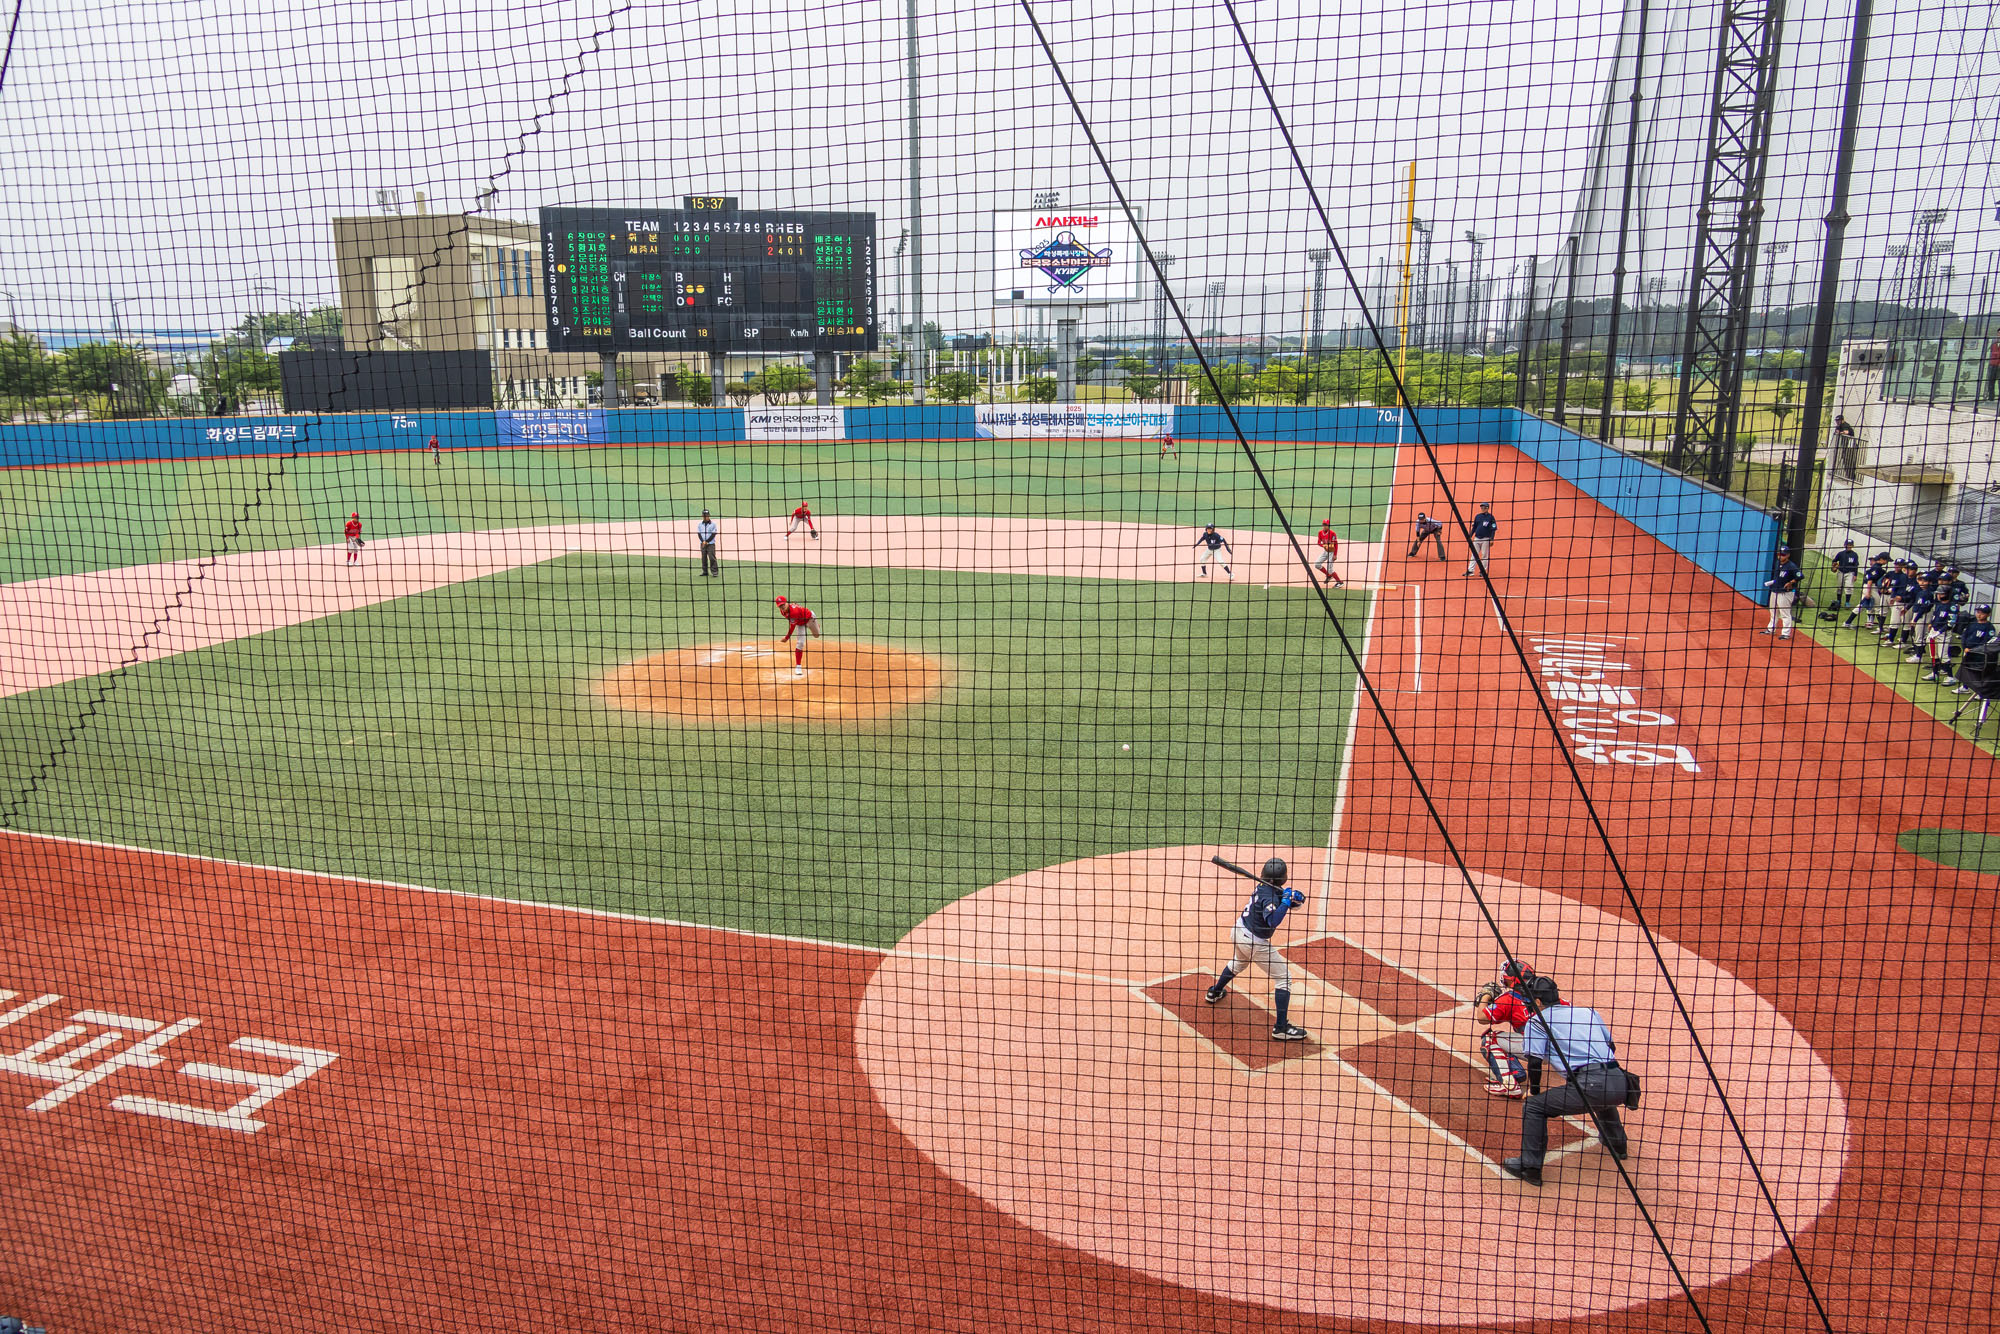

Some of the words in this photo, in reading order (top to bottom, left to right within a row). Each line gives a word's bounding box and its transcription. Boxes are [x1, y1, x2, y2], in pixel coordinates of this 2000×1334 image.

[692, 198, 724, 210] 15:37
[625, 221, 660, 231] TEAM
[1036, 216, 1098, 228] 시사저널
[674, 222, 678, 232] 1
[683, 222, 690, 232] 2
[694, 222, 700, 232] 3
[704, 222, 710, 232] 4
[714, 222, 720, 232] 5
[724, 222, 730, 232] 6
[734, 223, 740, 232] 7
[744, 223, 750, 232] 8
[754, 223, 760, 232] 9
[548, 232, 552, 240] 1
[768, 235, 773, 243] 0
[866, 236, 870, 245] 1
[548, 243, 554, 252] 2
[866, 246, 871, 255] 2
[1034, 238, 1050, 254] 2025
[768, 247, 773, 256] 2
[548, 254, 554, 262] 3
[866, 256, 871, 265] 3
[549, 264, 555, 273] 4
[866, 267, 871, 275] 4
[550, 275, 556, 283] 5
[614, 272, 626, 282] CH
[675, 272, 683, 282] B
[724, 272, 731, 282] H
[866, 277, 872, 285] 5
[551, 285, 556, 294] 6
[676, 285, 684, 294] S
[724, 285, 731, 294] E
[866, 287, 872, 295] 6
[551, 296, 557, 304] 7
[866, 297, 872, 305] 7
[552, 306, 558, 315] 8
[552, 317, 559, 325] 9
[867, 317, 872, 325] 9
[563, 327, 570, 336] P
[628, 329, 651, 338] Ball
[653, 329, 686, 338] Count
[744, 328, 759, 337] SP
[818, 327, 825, 335] P
[773, 415, 838, 423] 한국의학연구소
[1086, 413, 1168, 427] 전국유소년야구대회
[1377, 410, 1400, 422] 70m
[392, 416, 417, 429] 75m
[206, 426, 297, 442] 화성드림파크
